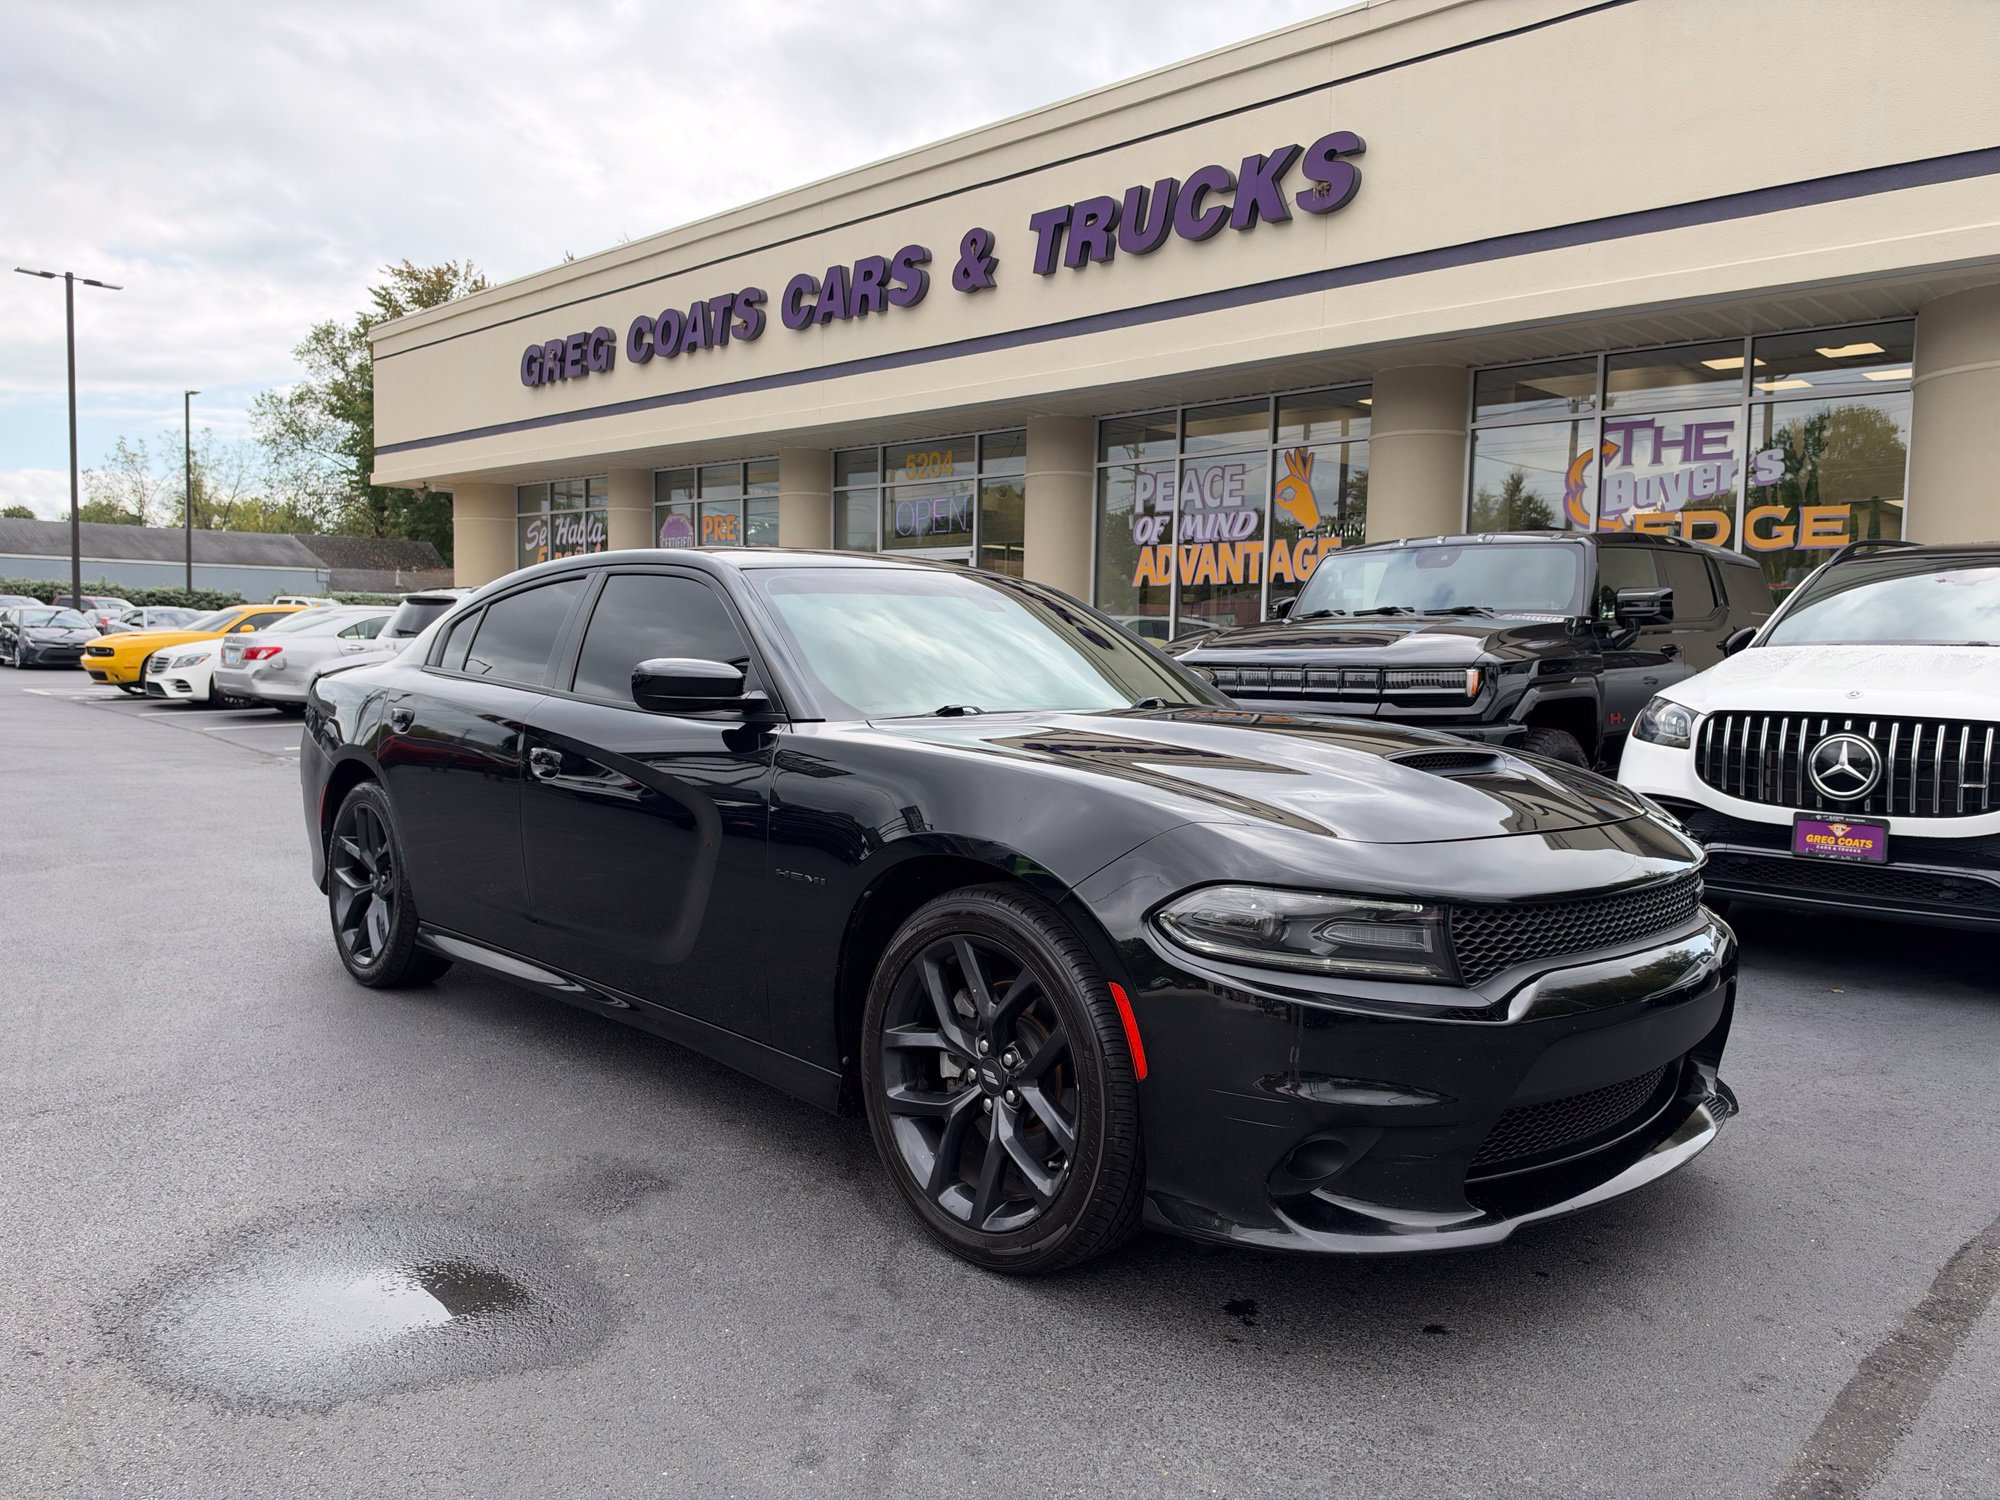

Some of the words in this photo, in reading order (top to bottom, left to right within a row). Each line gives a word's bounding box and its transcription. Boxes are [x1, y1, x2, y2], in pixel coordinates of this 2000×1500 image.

[520, 325, 616, 388] GREG
[626, 287, 768, 365] COATS
[781, 244, 932, 331] CARS
[952, 227, 998, 294] &
[1029, 130, 1367, 276] TRUCKS
[1603, 417, 1736, 466] THE
[904, 449, 955, 481] 5204
[1134, 463, 1246, 514] PEACE
[525, 519, 548, 551] Se
[555, 514, 606, 546] Habla
[895, 495, 968, 536] OPEN
[1133, 515, 1170, 546] OF
[1178, 510, 1260, 545] MIND
[1632, 504, 1852, 551] EDGE
[1805, 834, 1836, 845] GREG
[1837, 837, 1873, 849] COATS
[775, 868, 827, 887] HEMI
